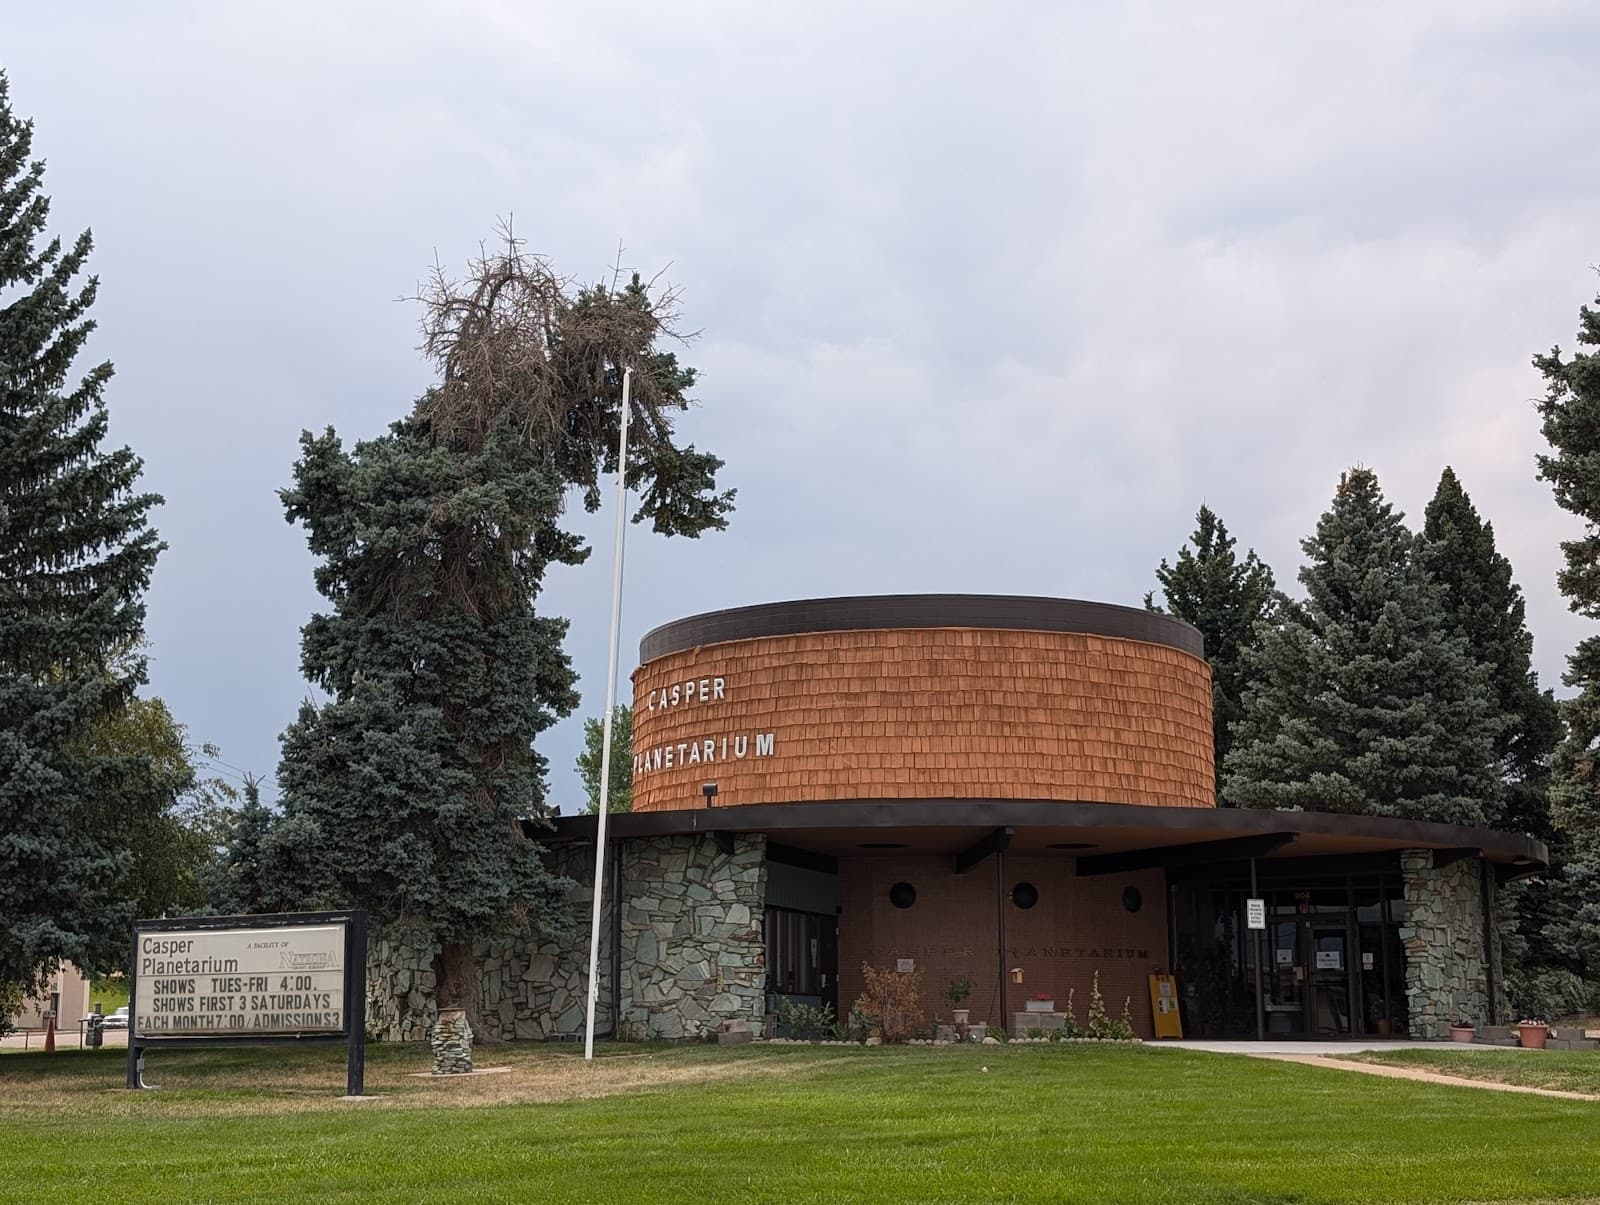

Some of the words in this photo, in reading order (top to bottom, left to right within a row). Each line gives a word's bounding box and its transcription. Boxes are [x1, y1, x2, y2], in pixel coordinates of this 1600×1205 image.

[648, 677, 725, 712] CASPER
[632, 733, 775, 775] PLANETARIUM
[143, 938, 194, 958] Casper
[142, 956, 238, 975] Planetarium
[153, 978, 196, 995] SHOWS
[211, 976, 268, 993] TUES-FRI
[153, 996, 195, 1013] SHOWS
[200, 995, 235, 1012] FIRST
[239, 995, 247, 1010] 3
[251, 993, 331, 1010] SATURDAYS
[137, 1015, 169, 1031] EACH
